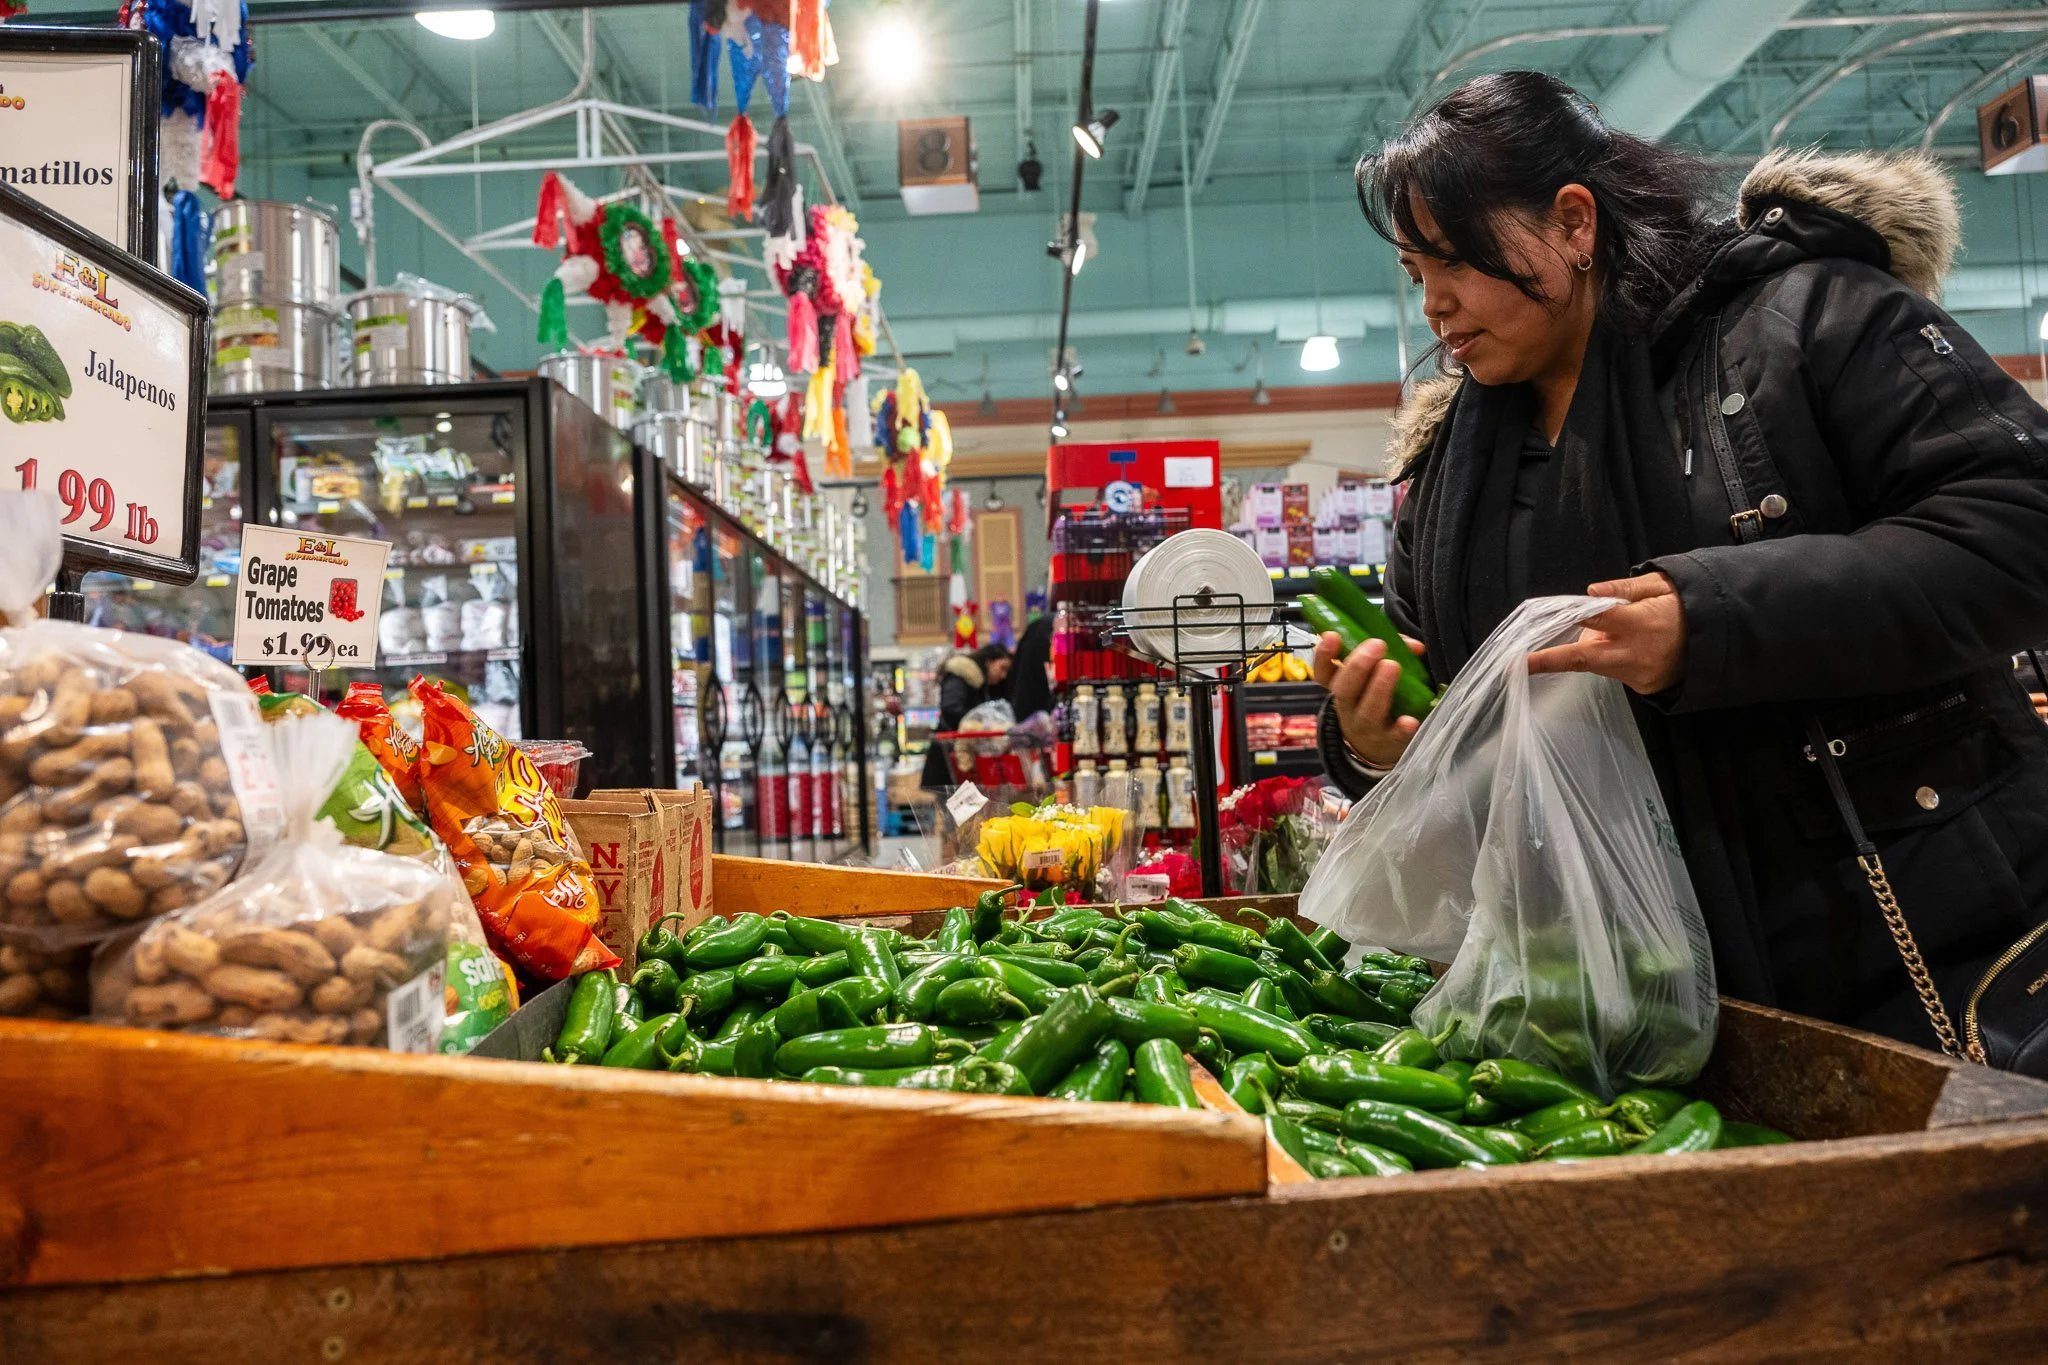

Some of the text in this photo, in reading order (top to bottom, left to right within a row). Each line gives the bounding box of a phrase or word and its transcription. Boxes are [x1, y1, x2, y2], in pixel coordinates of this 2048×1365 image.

[917, 129, 952, 175] 8
[52, 250, 119, 309] E&L
[84, 349, 176, 411] Jalapenos
[124, 502, 159, 544] lb
[285, 552, 349, 566] SUPERMERCADO
[297, 537, 341, 557] E&L
[247, 556, 298, 593] Grape
[245, 590, 324, 623] Tomatoes
[262, 631, 358, 657] $1.99 ea
